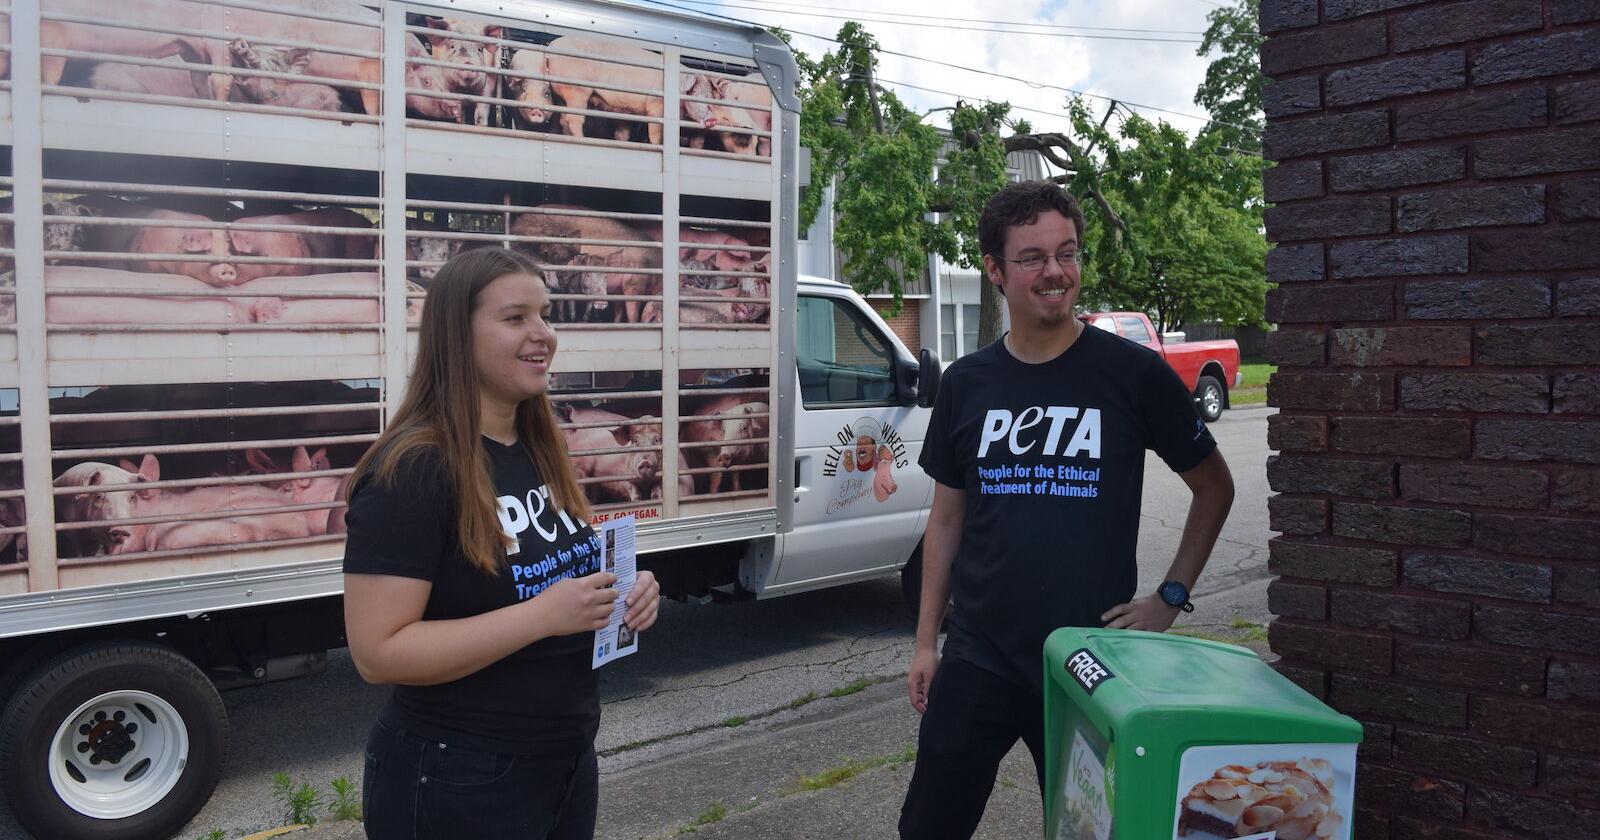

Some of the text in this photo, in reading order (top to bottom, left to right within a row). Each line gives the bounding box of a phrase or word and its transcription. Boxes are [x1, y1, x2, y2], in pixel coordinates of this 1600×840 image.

[823, 421, 909, 477] HELL ON WHEELS
[978, 464, 1100, 482] People for the Ethical
[980, 481, 1099, 498] Treatment of Animals
[496, 484, 588, 556] PeT
[511, 554, 558, 582] People
[557, 548, 572, 565] for
[573, 542, 590, 559] the
[1068, 651, 1108, 689] FREE
[1071, 749, 1103, 811] Vegan
